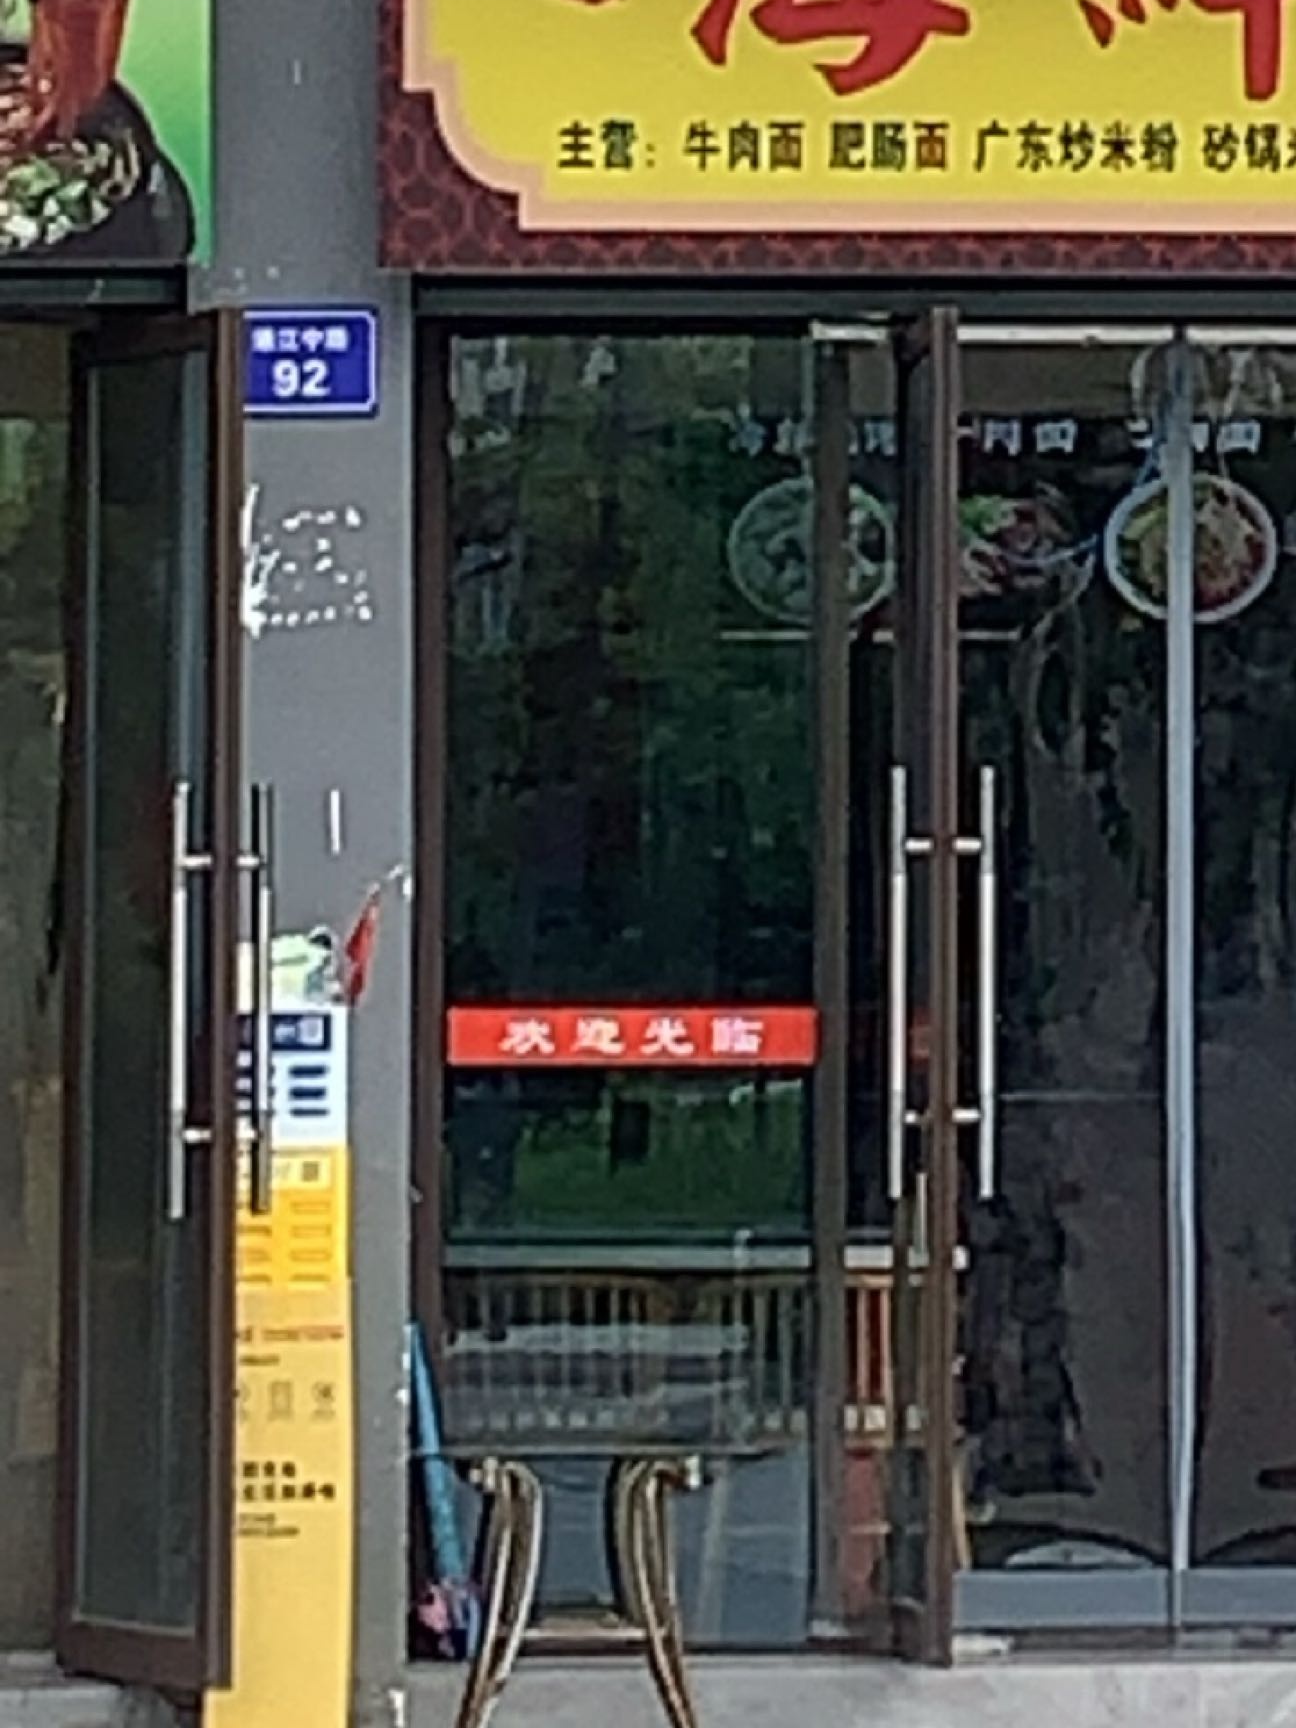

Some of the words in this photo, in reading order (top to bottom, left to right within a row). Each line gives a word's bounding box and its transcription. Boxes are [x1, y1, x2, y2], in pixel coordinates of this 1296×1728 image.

[683, 119, 806, 172] 牛肉面
[829, 121, 951, 172] 肥肠面
[972, 120, 1180, 173] 广东炒米粉
[271, 358, 333, 398] 92
[498, 1016, 765, 1056] 欢迎光临
